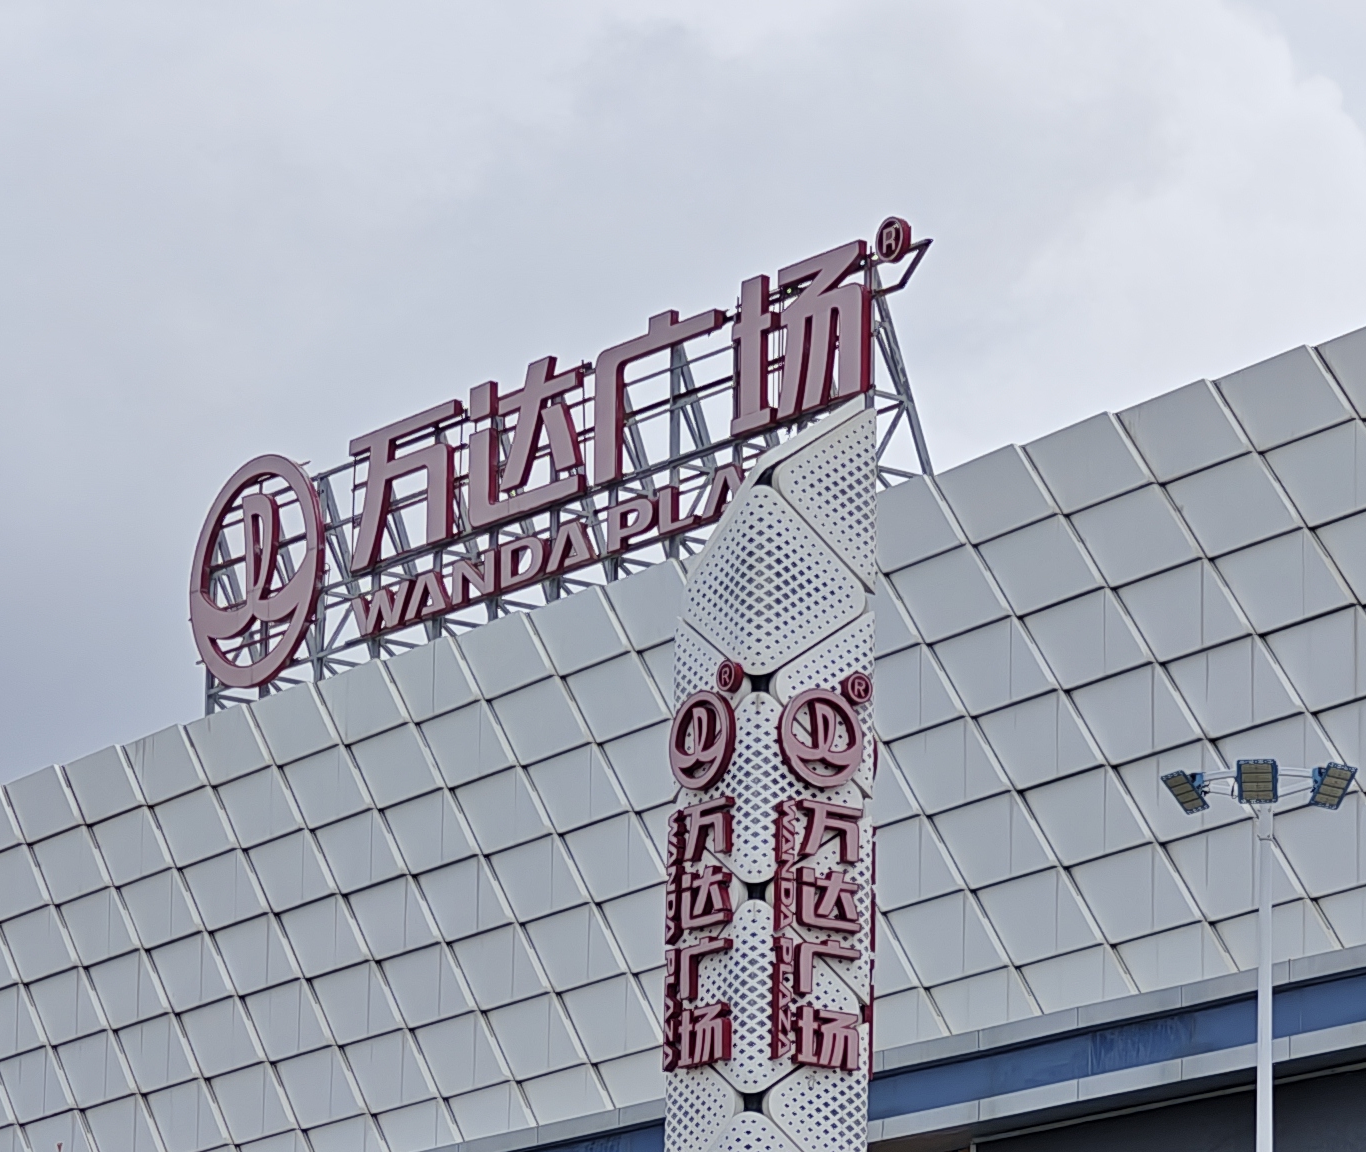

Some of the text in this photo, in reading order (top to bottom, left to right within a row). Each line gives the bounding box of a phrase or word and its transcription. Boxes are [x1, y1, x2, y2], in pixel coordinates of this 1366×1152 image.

[349, 239, 872, 575] 万达广场
[351, 520, 598, 636] WANDA
[678, 796, 735, 1069] 万达广场
[771, 799, 797, 1060] WANDA PLAZA
[793, 798, 864, 1072] 万达广场
